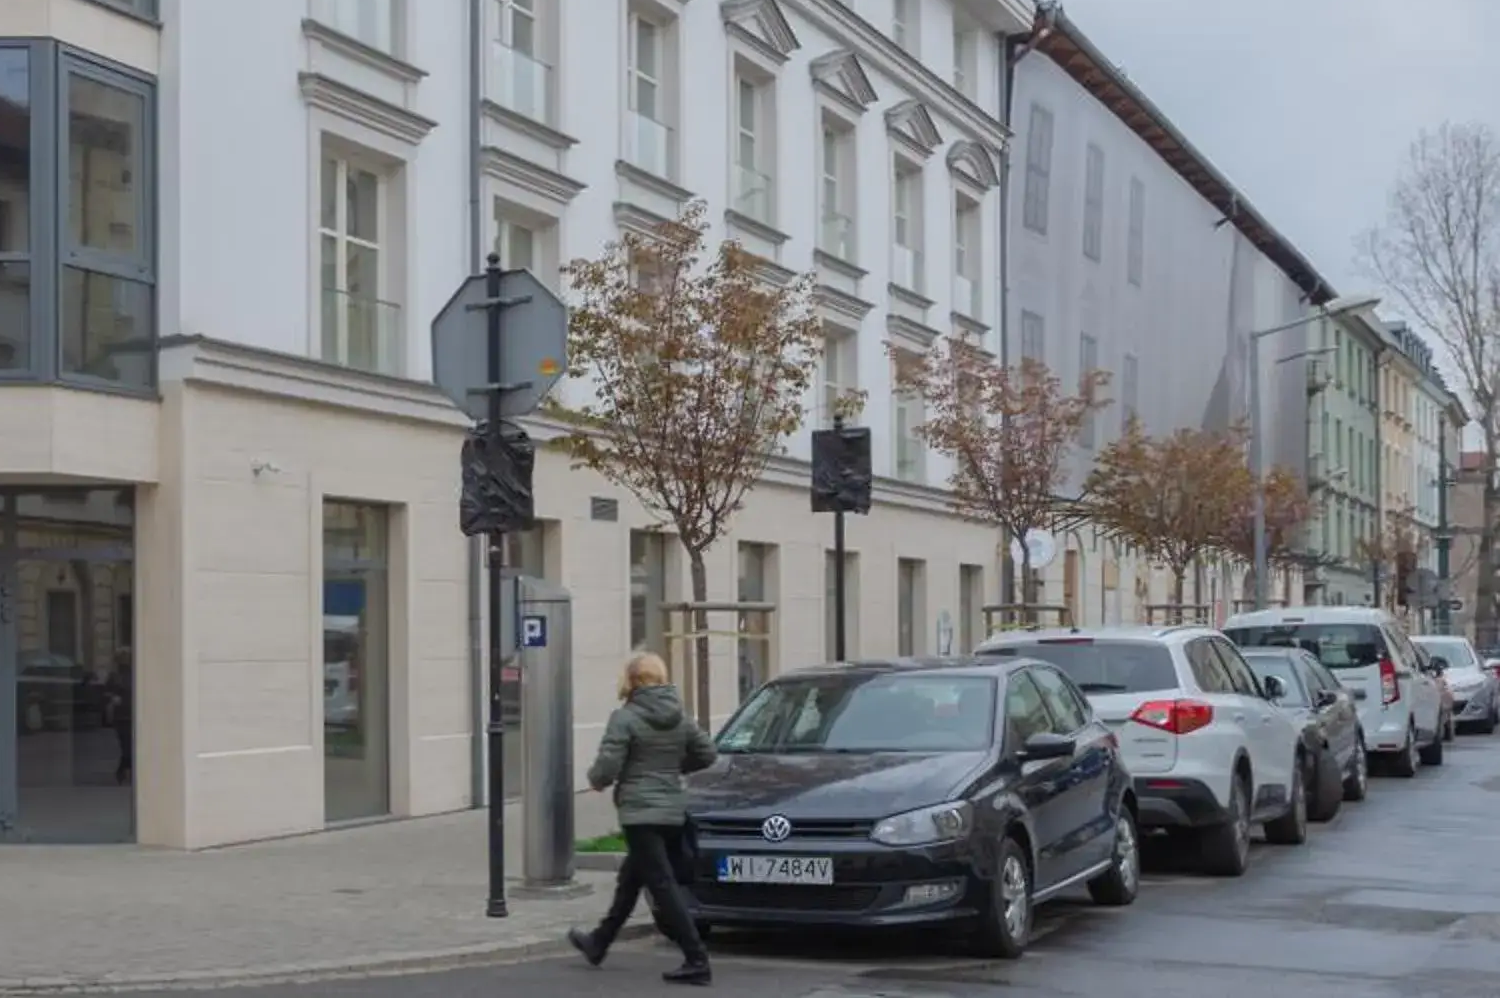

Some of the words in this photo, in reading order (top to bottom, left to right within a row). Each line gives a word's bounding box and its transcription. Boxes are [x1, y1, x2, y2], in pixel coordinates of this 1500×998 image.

[523, 619, 541, 645] P
[731, 857, 754, 875] WI
[765, 858, 830, 878] 7484V
